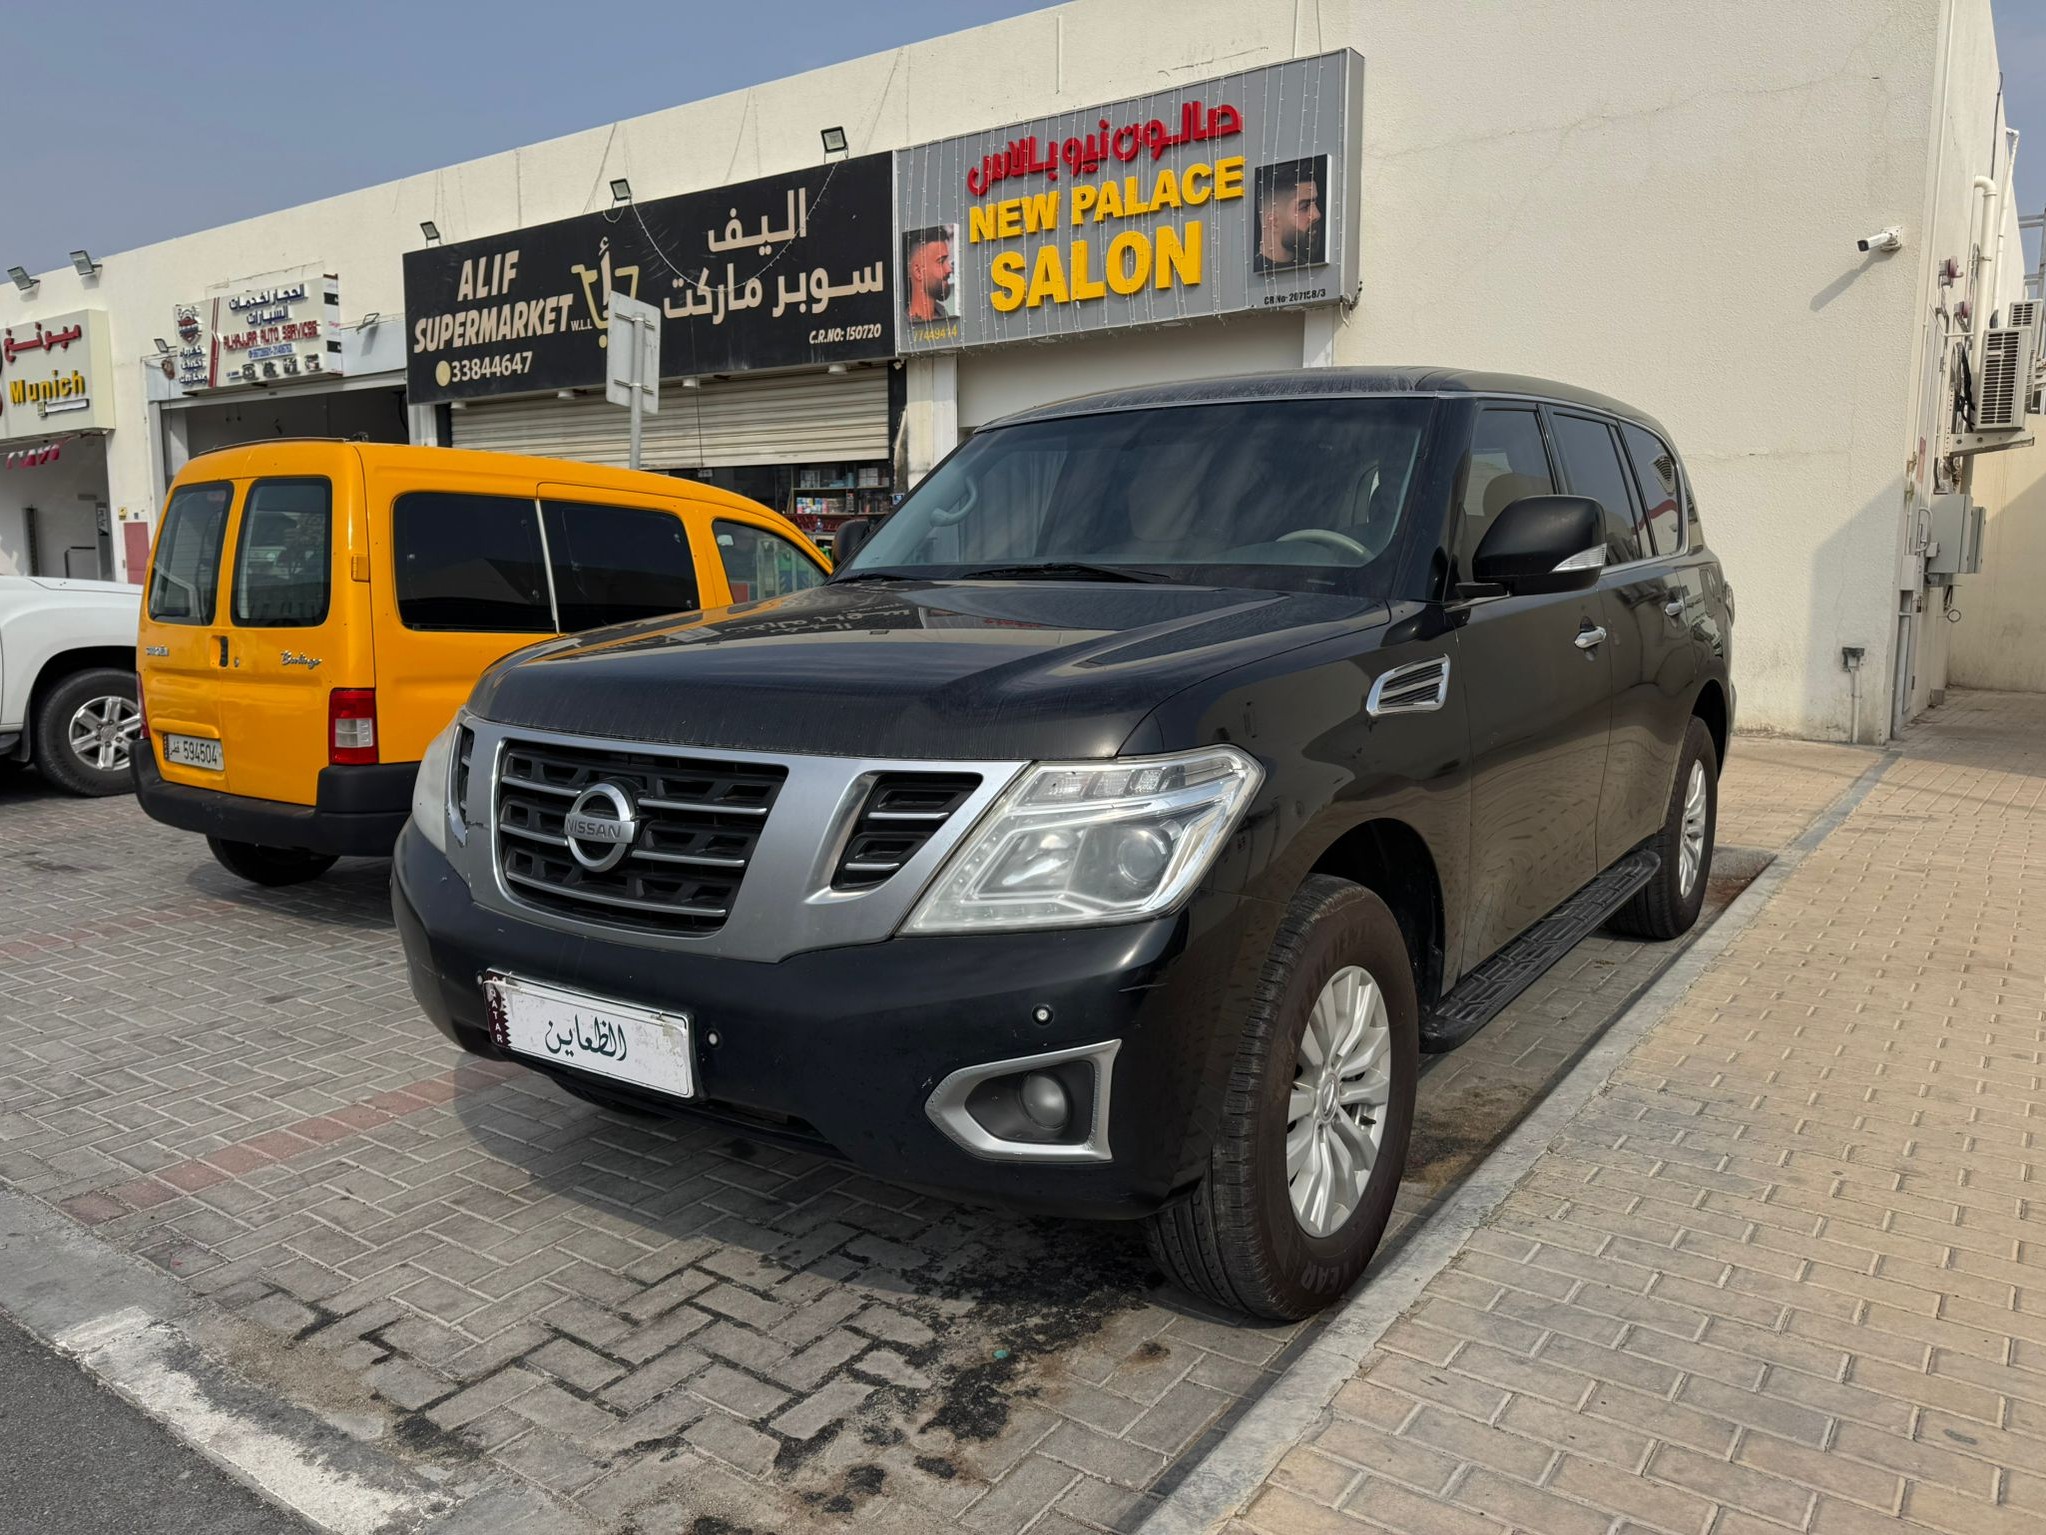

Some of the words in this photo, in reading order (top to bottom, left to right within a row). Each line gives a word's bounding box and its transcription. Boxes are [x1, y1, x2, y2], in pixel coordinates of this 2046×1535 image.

[1062, 119, 1109, 176] نيو
[1112, 101, 1242, 162] صالون
[967, 135, 1059, 197] بالاس
[708, 187, 807, 256] اليف
[968, 189, 1060, 244] NEW
[1071, 155, 1246, 226] PALACE
[457, 250, 520, 301] ALIF
[663, 263, 763, 325] ماركت
[772, 261, 884, 318] سوبر
[990, 220, 1203, 312] SALON
[3, 321, 82, 364] ميونخ
[247, 305, 289, 326] السيارات
[260, 327, 279, 345] AUTO
[282, 320, 318, 342] SERVICES
[413, 293, 574, 354] SUPERMARKET
[846, 323, 882, 342] 150720
[10, 369, 86, 405] Munich
[451, 351, 534, 383] 33844647
[183, 741, 218, 765] 594504
[566, 818, 622, 840] NISSAN
[488, 988, 504, 1044] QATAR
